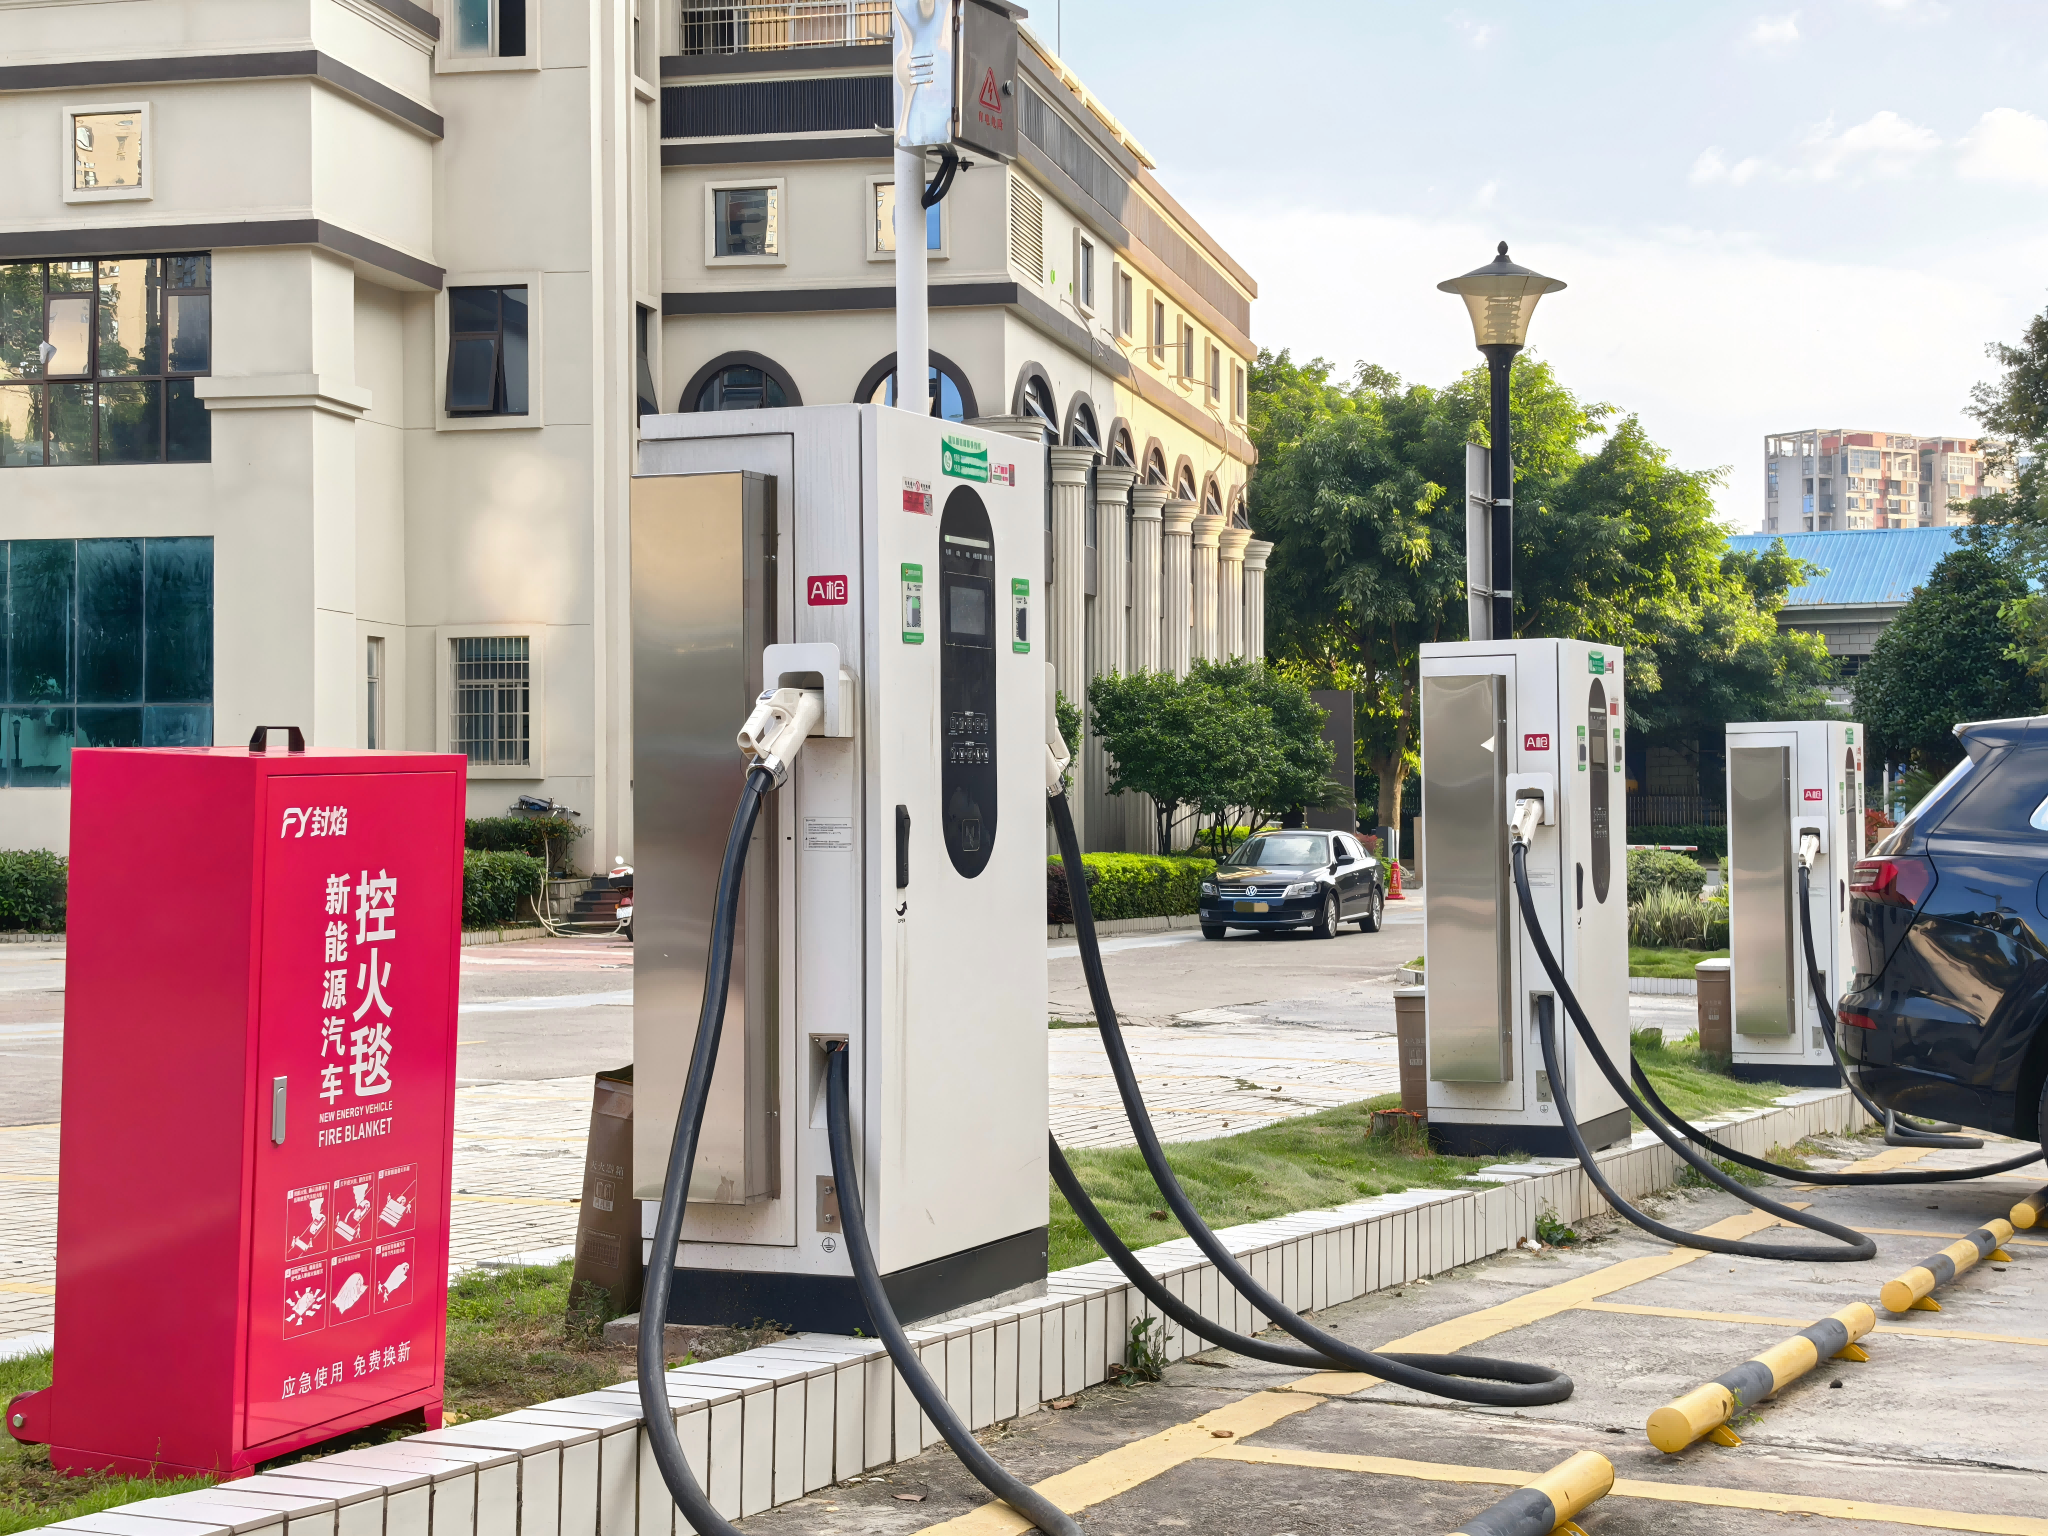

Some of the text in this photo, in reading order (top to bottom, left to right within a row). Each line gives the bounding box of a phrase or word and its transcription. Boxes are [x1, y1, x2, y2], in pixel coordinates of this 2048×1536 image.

[810, 580, 845, 600] A枪
[319, 873, 351, 1105] 新能源汽车
[349, 868, 398, 1097] 控火毯
[318, 1116, 393, 1148] FIRE BLANKET
[319, 1100, 393, 1124] NEW ENERGY VEHICLE
[281, 1340, 411, 1400] 应急使用 免费换新
